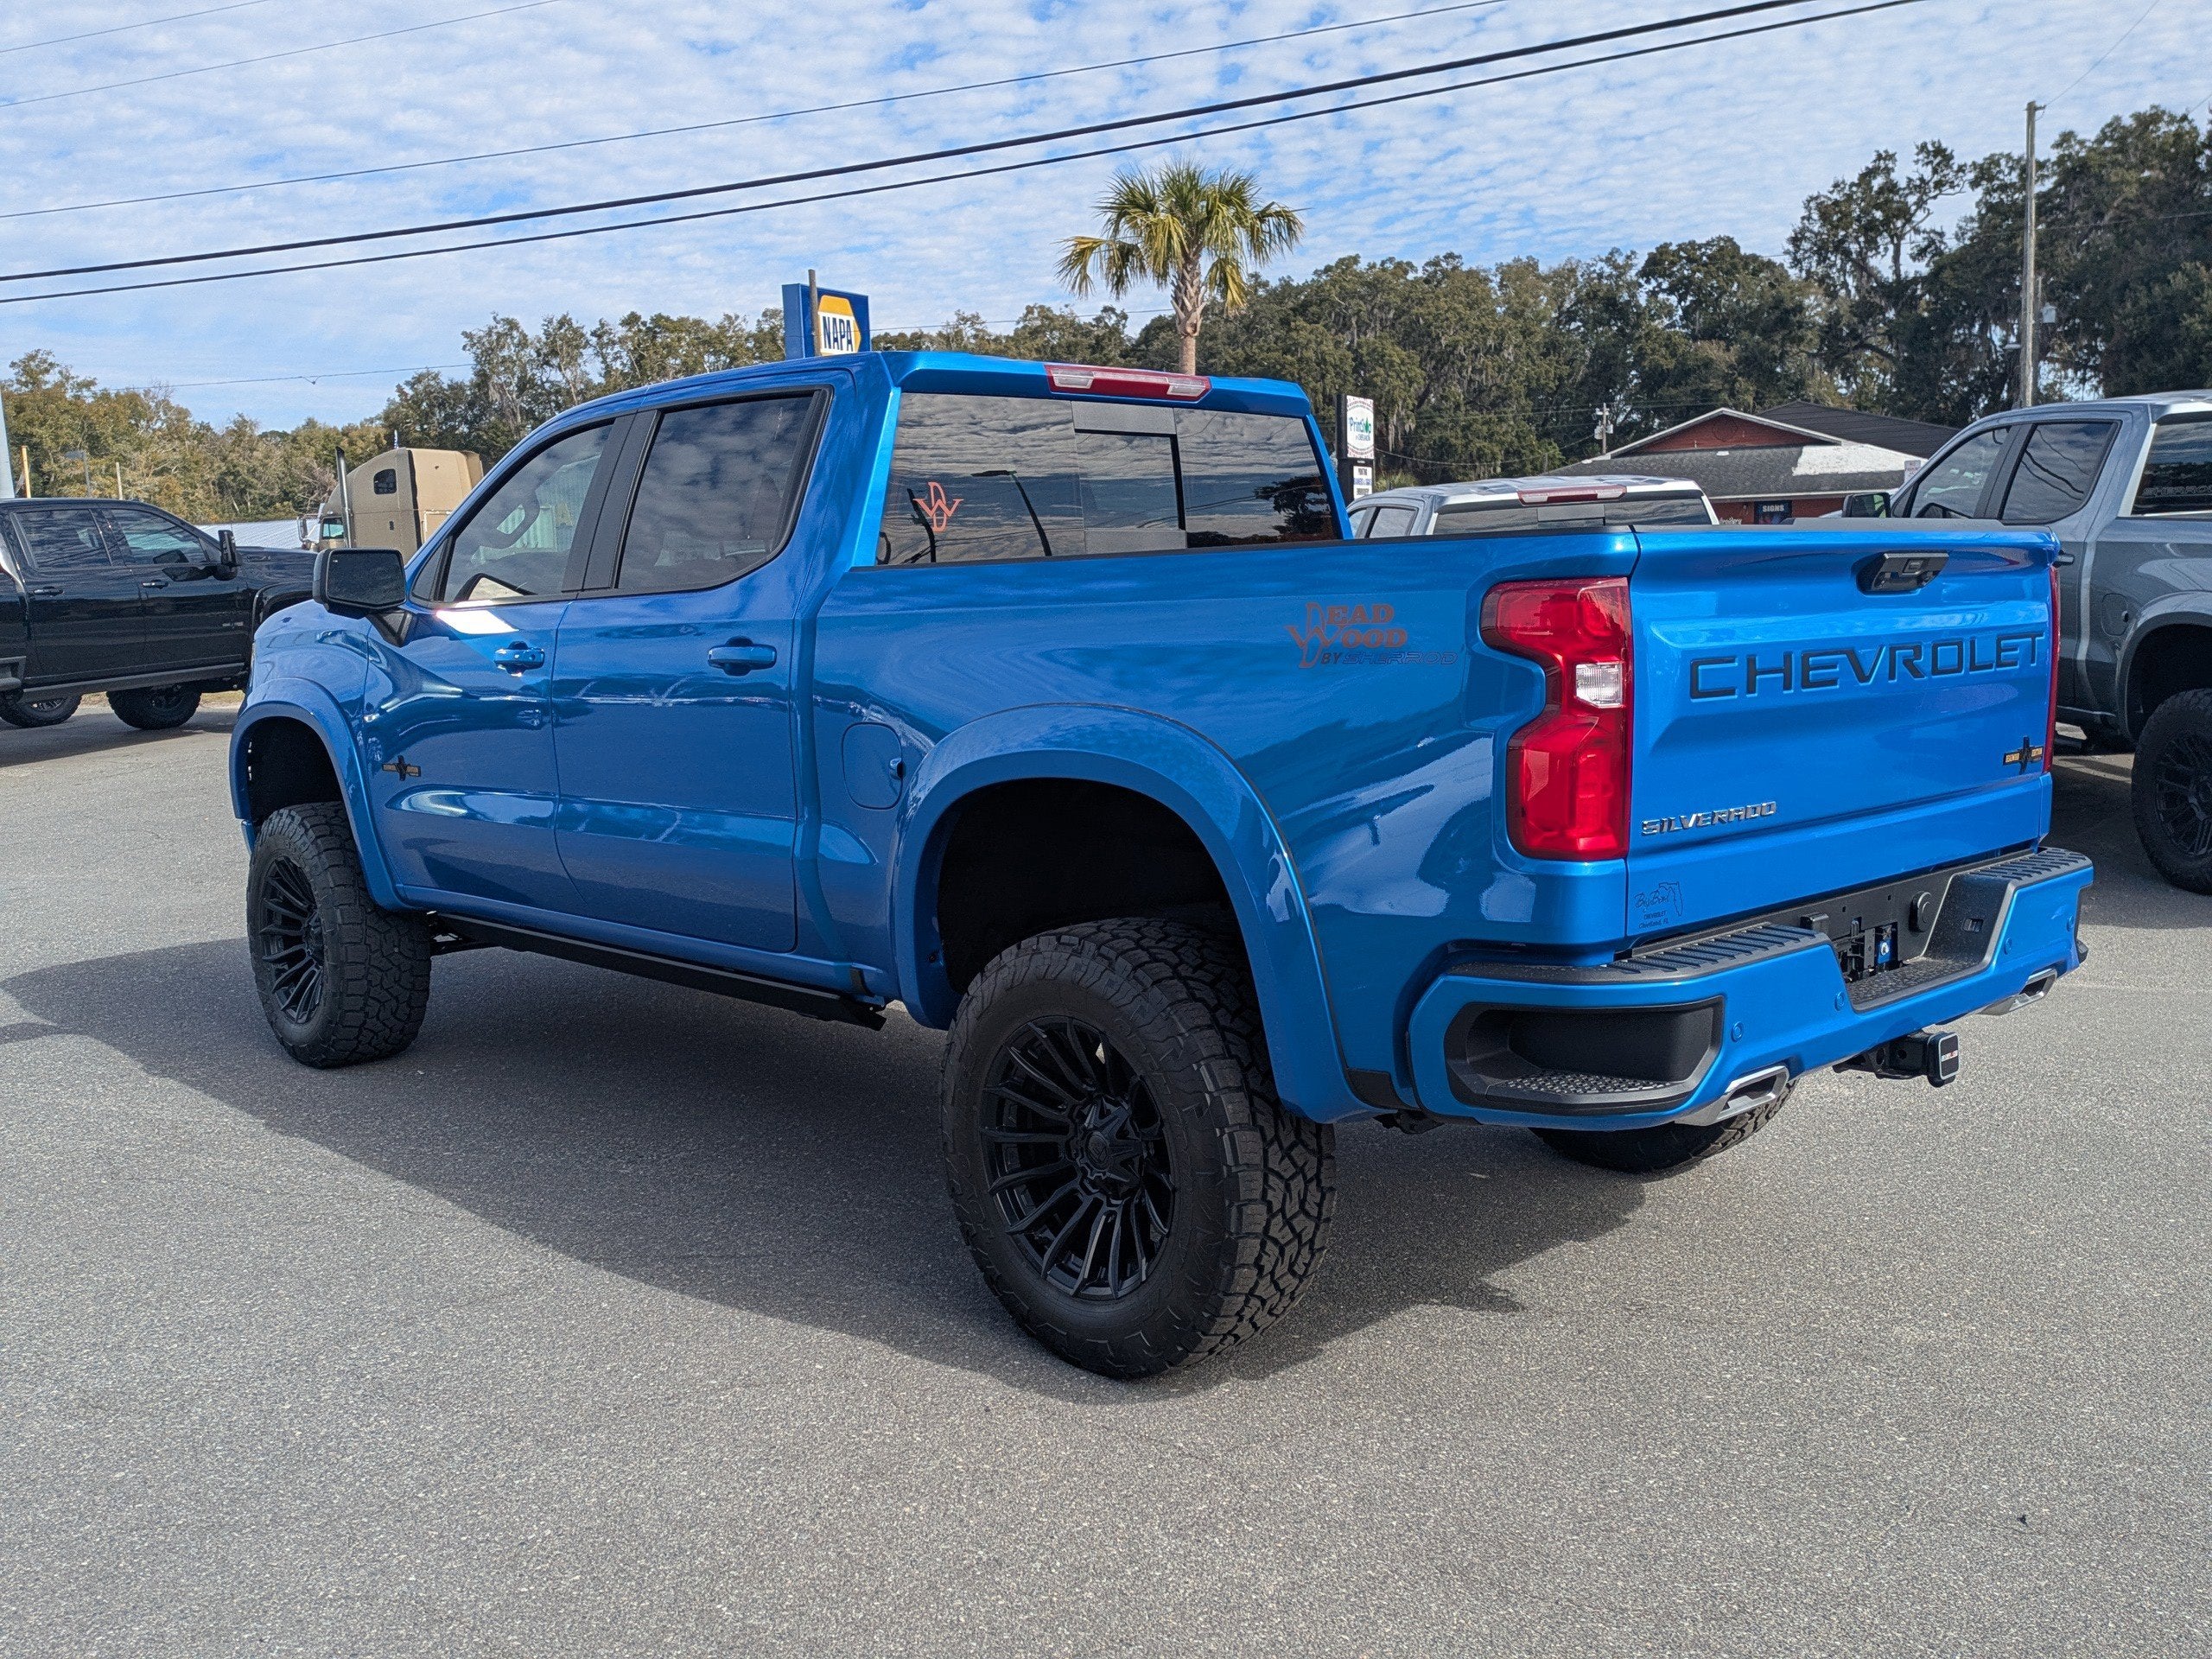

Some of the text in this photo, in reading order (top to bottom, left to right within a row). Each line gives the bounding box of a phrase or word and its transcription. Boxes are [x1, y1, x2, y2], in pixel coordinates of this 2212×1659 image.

[822, 315, 855, 353] NAPA
[1762, 504, 1785, 512] SIGNS
[1284, 625, 1408, 648] WOOD
[1320, 651, 1459, 664] BY SHERROD
[1689, 631, 2045, 702] CHEVROLET
[1642, 801, 1777, 836] SILVERADO
